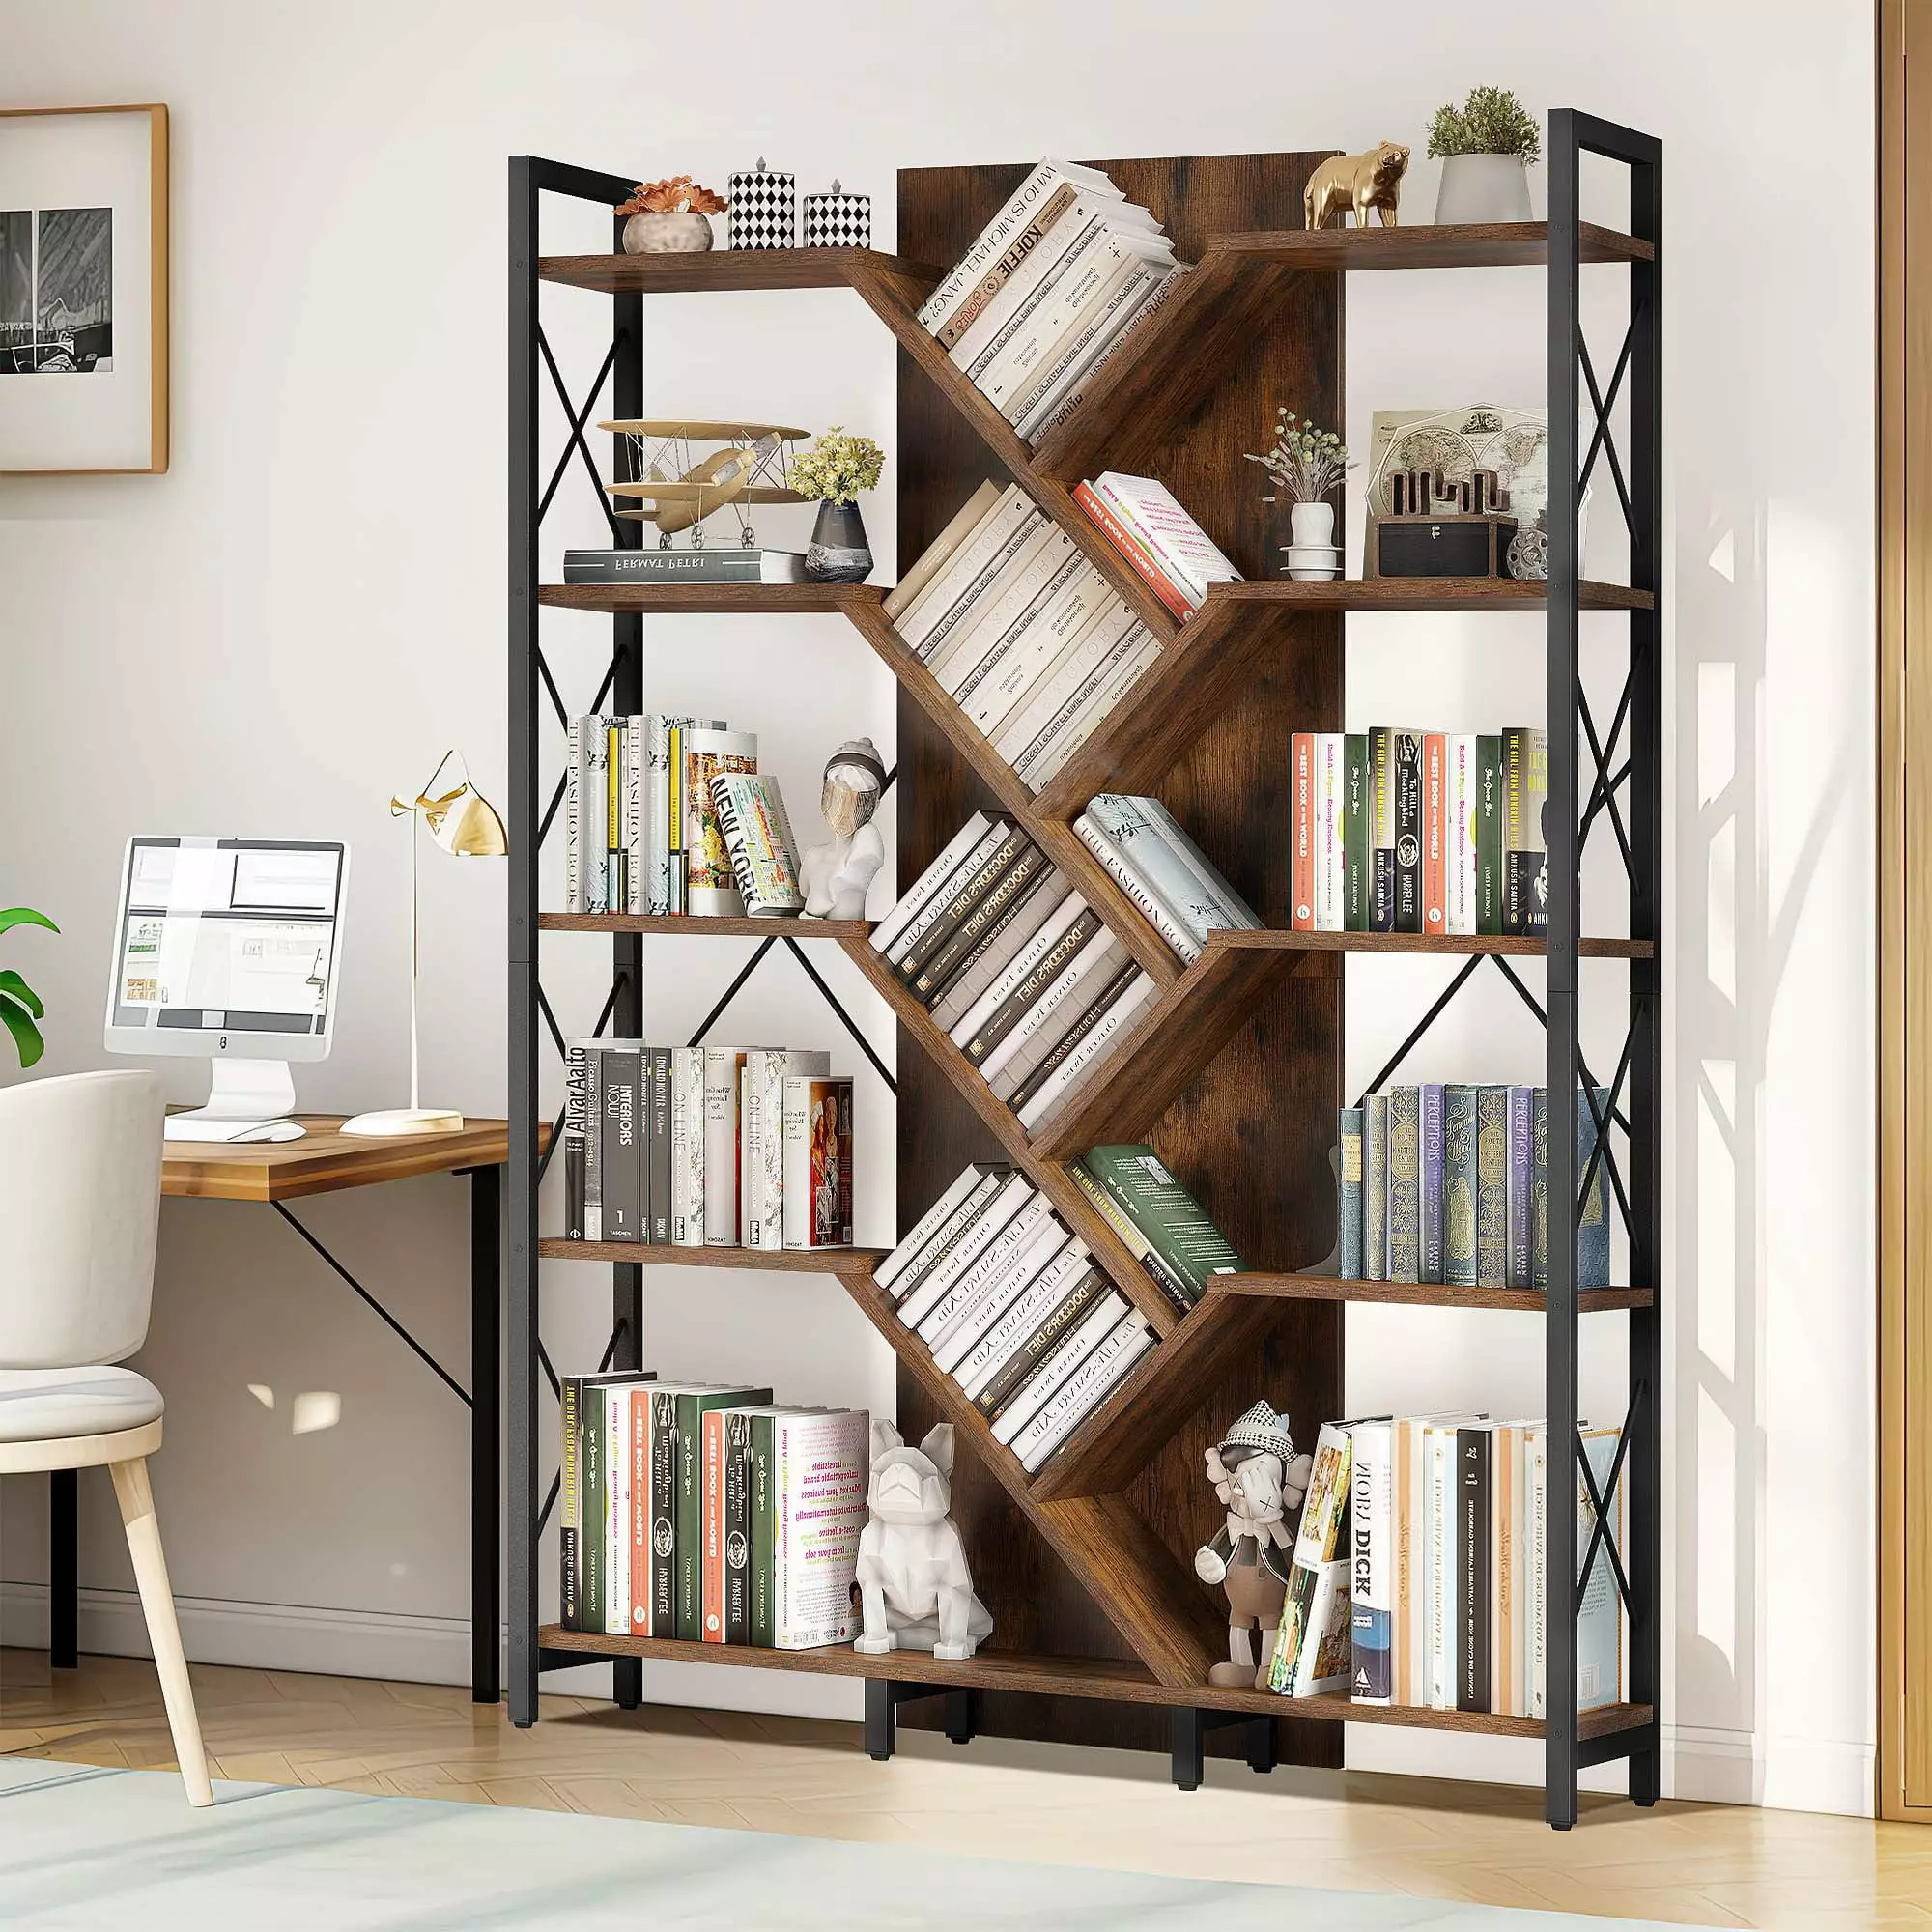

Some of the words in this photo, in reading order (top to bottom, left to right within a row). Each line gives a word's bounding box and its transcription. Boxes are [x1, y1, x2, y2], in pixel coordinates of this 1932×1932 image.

[1020, 163, 1057, 204] WHO
[1009, 198, 1029, 218] IS
[960, 213, 1016, 277] MICHAEL
[994, 223, 1045, 280] KOFFIE
[926, 271, 968, 318] JANG?
[950, 290, 989, 333] STORIES
[568, 721, 578, 759] THE
[630, 722, 639, 761] THE
[1377, 750, 1385, 765] GIRL
[1377, 769, 1385, 787] FROM
[1398, 768, 1408, 827] Mockingbird
[1408, 778, 1416, 788] To
[568, 766, 578, 845] FASHION
[630, 767, 639, 846] FASHION
[711, 778, 740, 836] NEW
[730, 838, 762, 914] YORK
[568, 853, 578, 904] BOOK
[629, 854, 639, 906] BOOK
[1104, 854, 1163, 925] FASHION
[1401, 874, 1412, 898] HARPER
[1402, 900, 1412, 912] LEE
[587, 1061, 597, 1090] Picasso
[587, 1093, 597, 1126] Guitars
[607, 1084, 618, 1118] NOW!
[619, 1084, 632, 1145] INTERIORS
[673, 1093, 686, 1113] ON
[748, 1095, 759, 1115] ON
[673, 1120, 686, 1151] LINE
[749, 1122, 759, 1154] LINE
[1428, 1094, 1439, 1160] PERCEPTIONS
[1516, 1097, 1529, 1166] PERCEPTIONS
[616, 1210, 622, 1223] 1
[750, 1221, 758, 1244] MoMA
[1354, 1530, 1370, 1596] DICK
